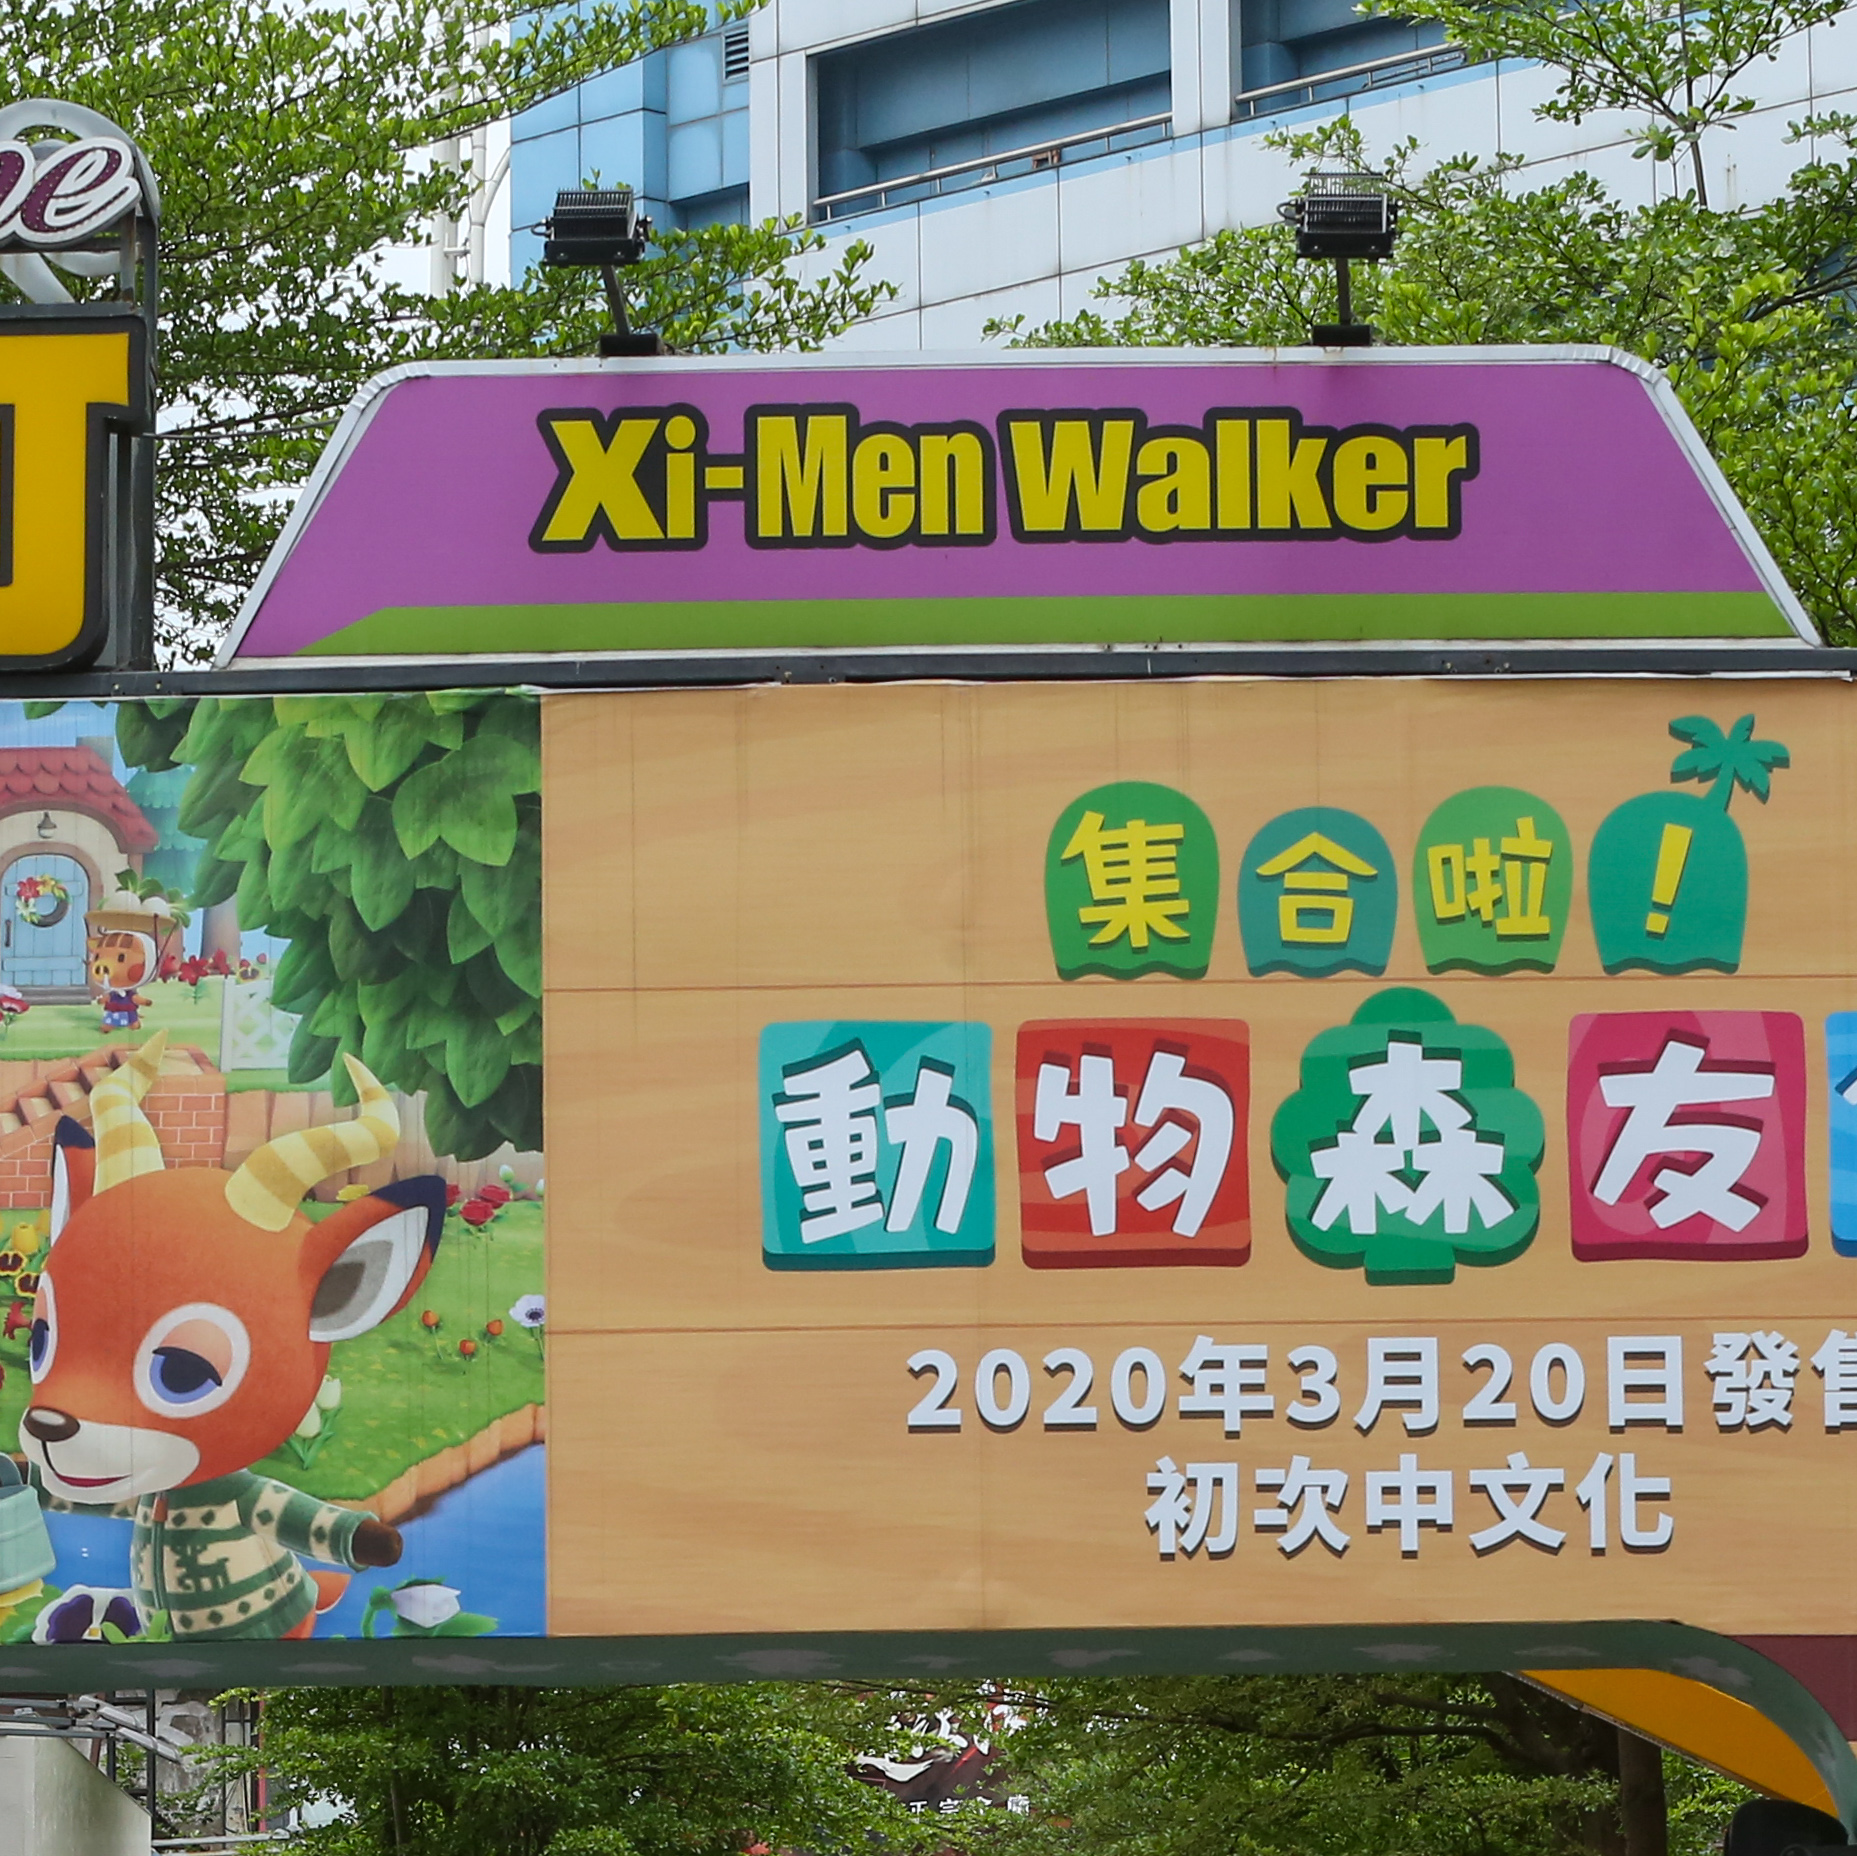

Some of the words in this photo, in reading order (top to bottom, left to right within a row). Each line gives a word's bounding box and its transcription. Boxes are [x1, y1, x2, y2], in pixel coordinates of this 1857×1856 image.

[541, 410, 986, 542] Xi-Men
[1010, 416, 1468, 534] Walker
[1144, 1453, 1675, 1554] 初次中文化
